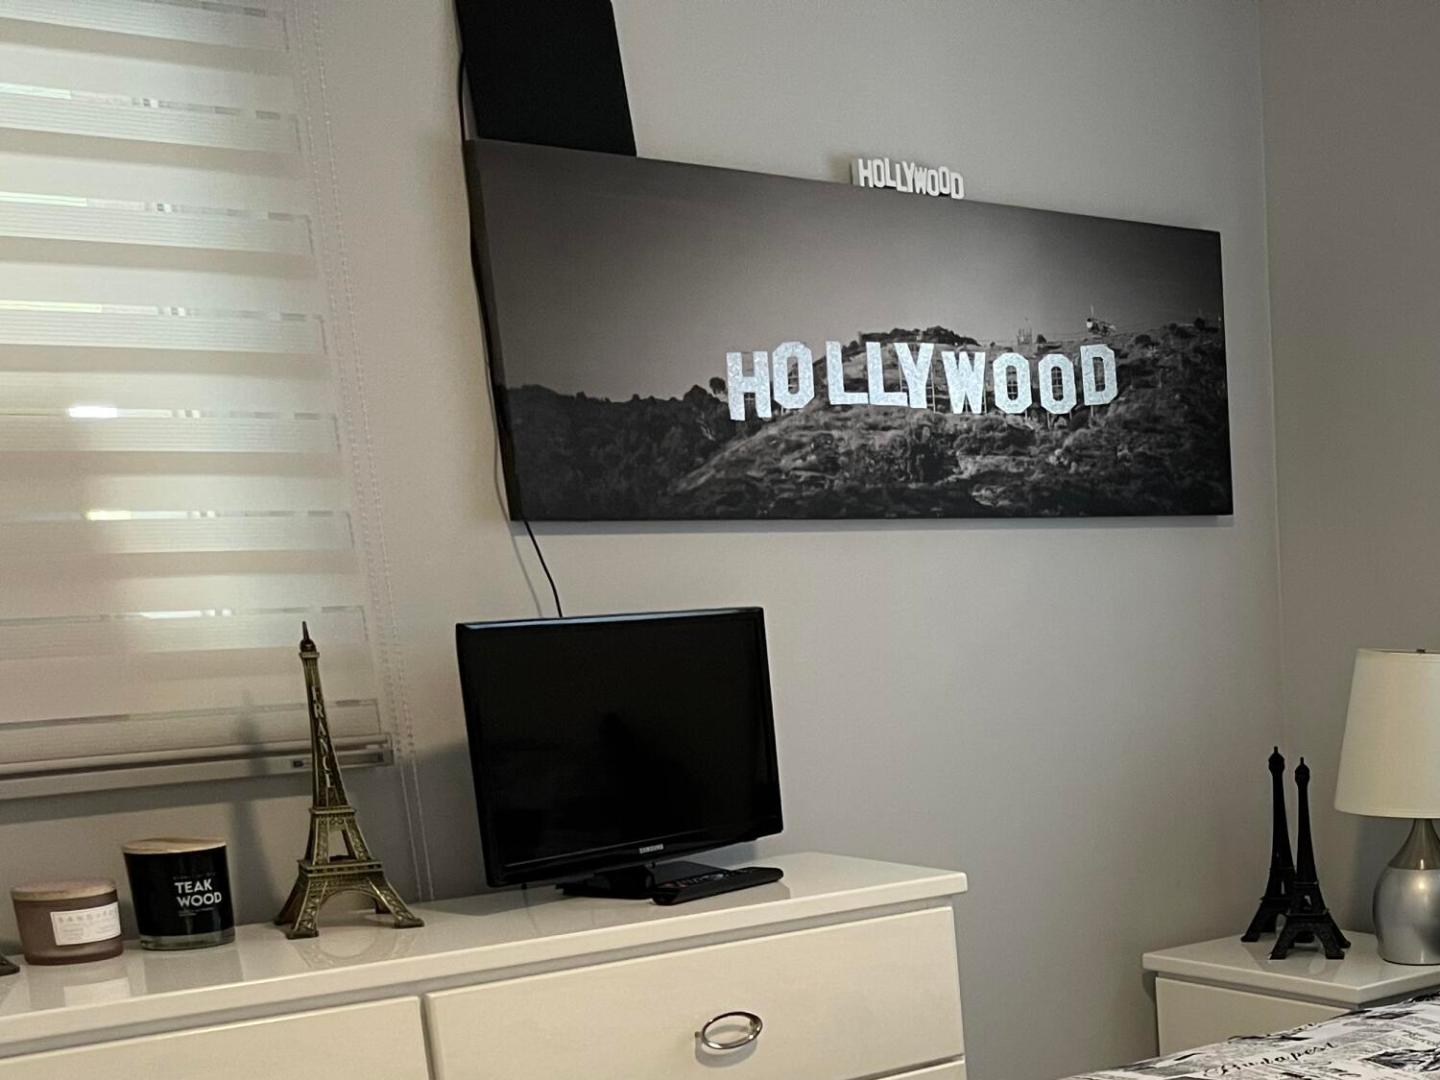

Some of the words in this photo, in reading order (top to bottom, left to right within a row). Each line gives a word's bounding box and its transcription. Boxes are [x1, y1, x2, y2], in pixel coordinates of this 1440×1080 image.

[857, 157, 965, 199] HOLLYWOOD
[726, 341, 1118, 421] HOLLYWOOD
[174, 878, 212, 894] TEAK
[176, 891, 222, 907] WOOD
